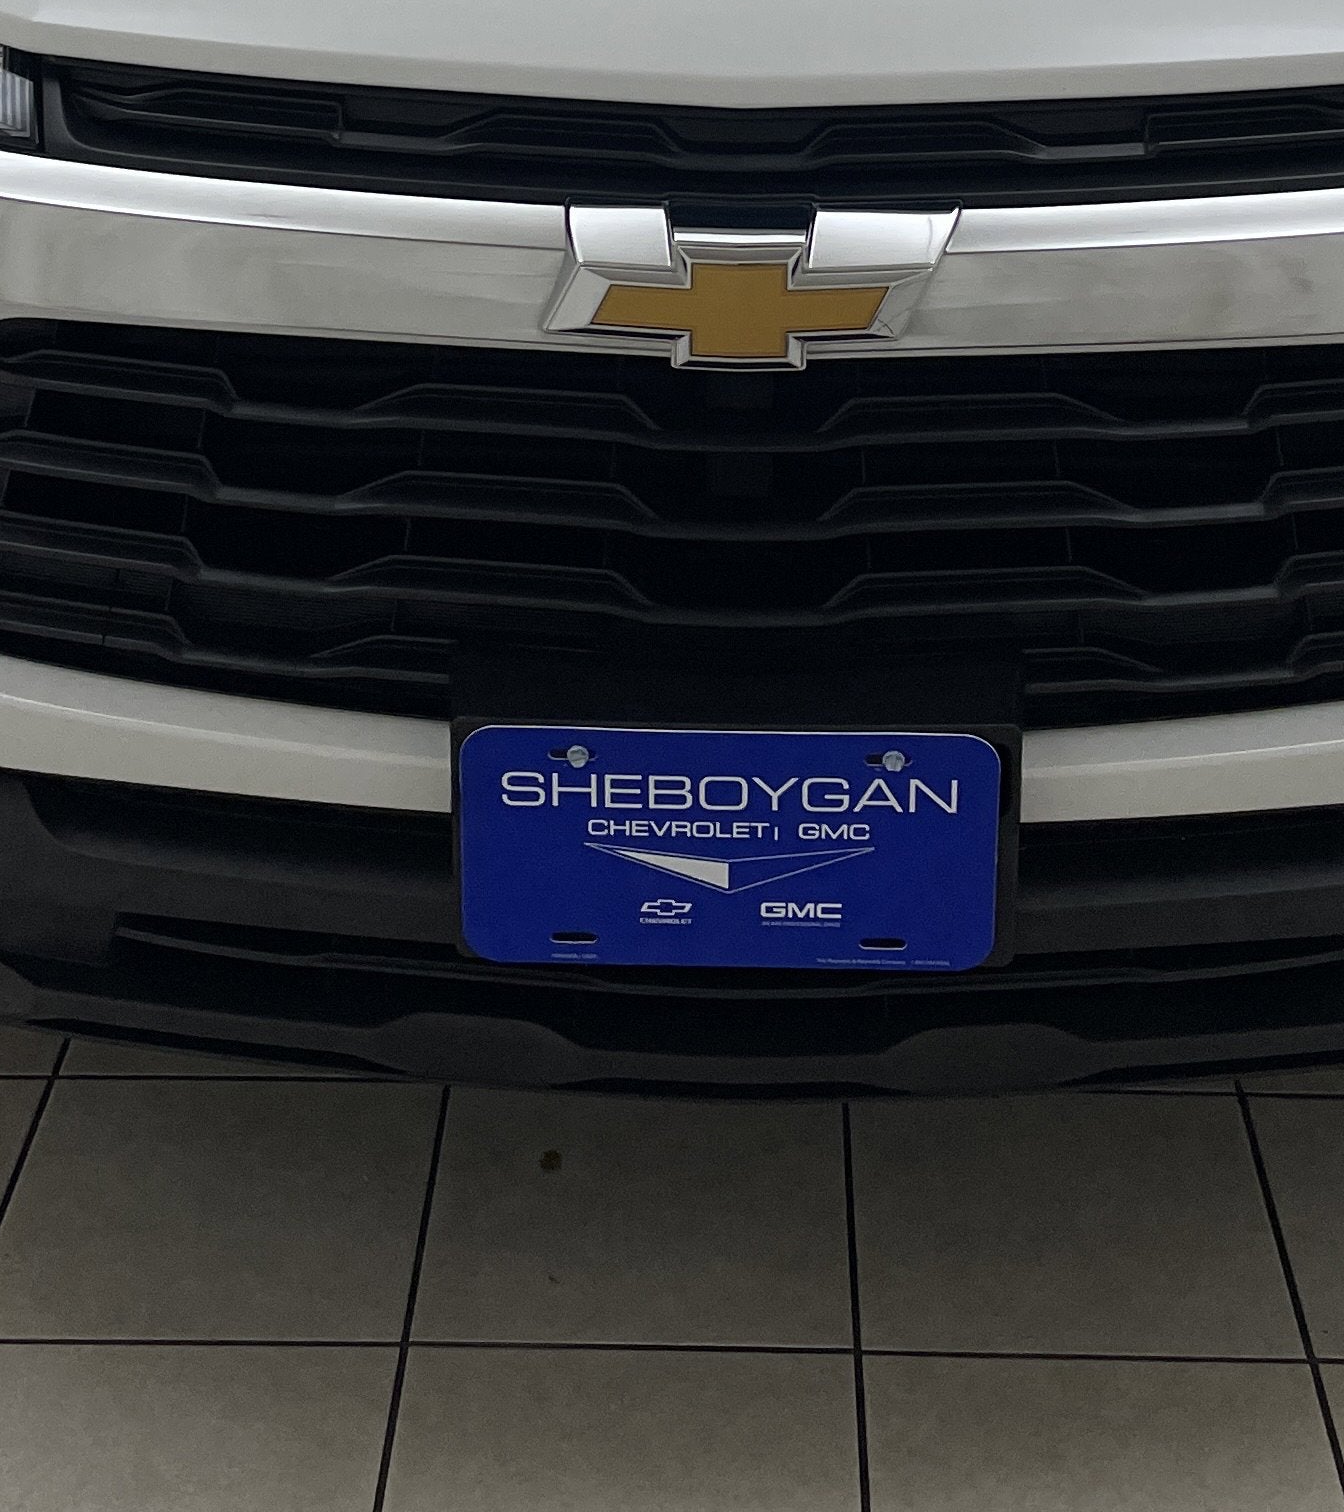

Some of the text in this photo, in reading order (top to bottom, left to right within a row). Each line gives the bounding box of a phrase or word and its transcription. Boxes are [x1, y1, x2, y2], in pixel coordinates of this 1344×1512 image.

[500, 771, 959, 814] SHEBOYGAN
[587, 819, 770, 839] CHEVROLET
[798, 823, 871, 840] GMC
[760, 902, 843, 919] GMC
